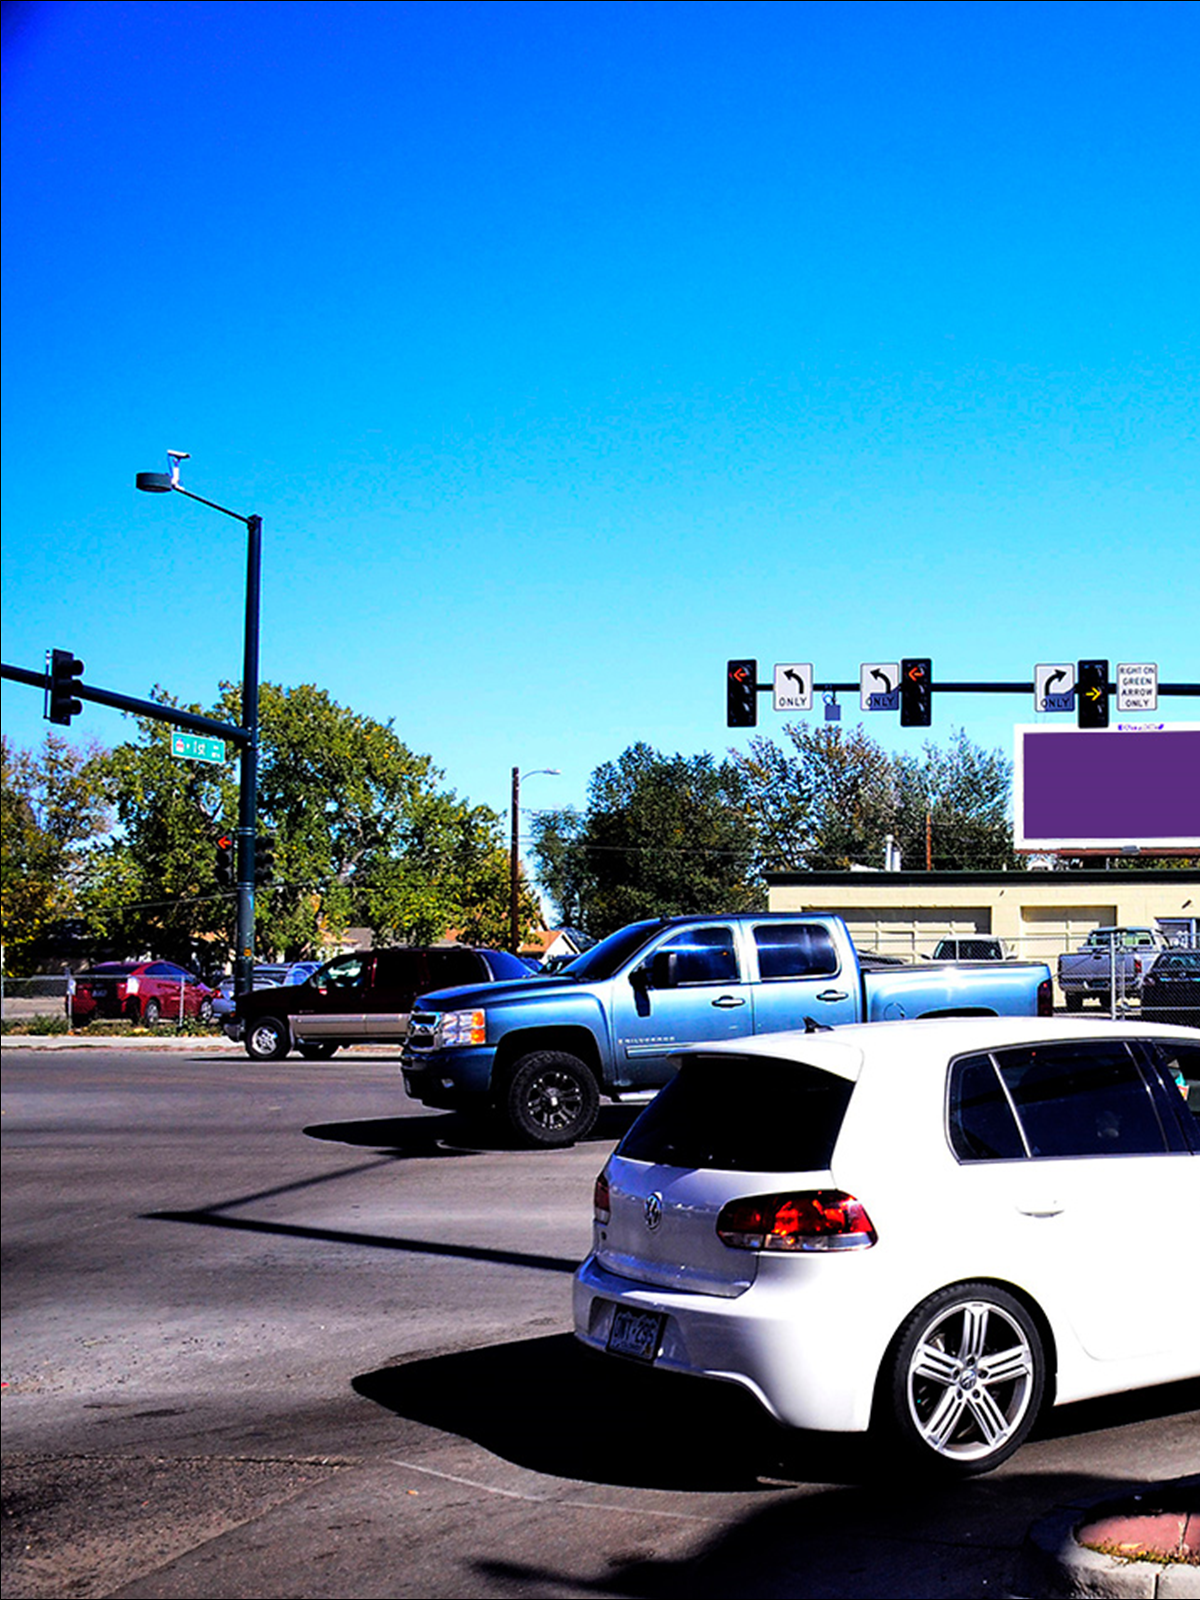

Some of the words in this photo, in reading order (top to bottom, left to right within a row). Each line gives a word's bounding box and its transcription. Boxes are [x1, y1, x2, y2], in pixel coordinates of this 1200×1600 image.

[1119, 666, 1140, 675] RIGHT
[1143, 666, 1155, 674] ON
[1122, 678, 1153, 686] GREEN
[1121, 688, 1153, 697] ARROW
[778, 697, 808, 707] ONLY
[865, 697, 895, 707] ONLY
[1040, 698, 1071, 708] ONLY
[1125, 699, 1149, 708] ONLY
